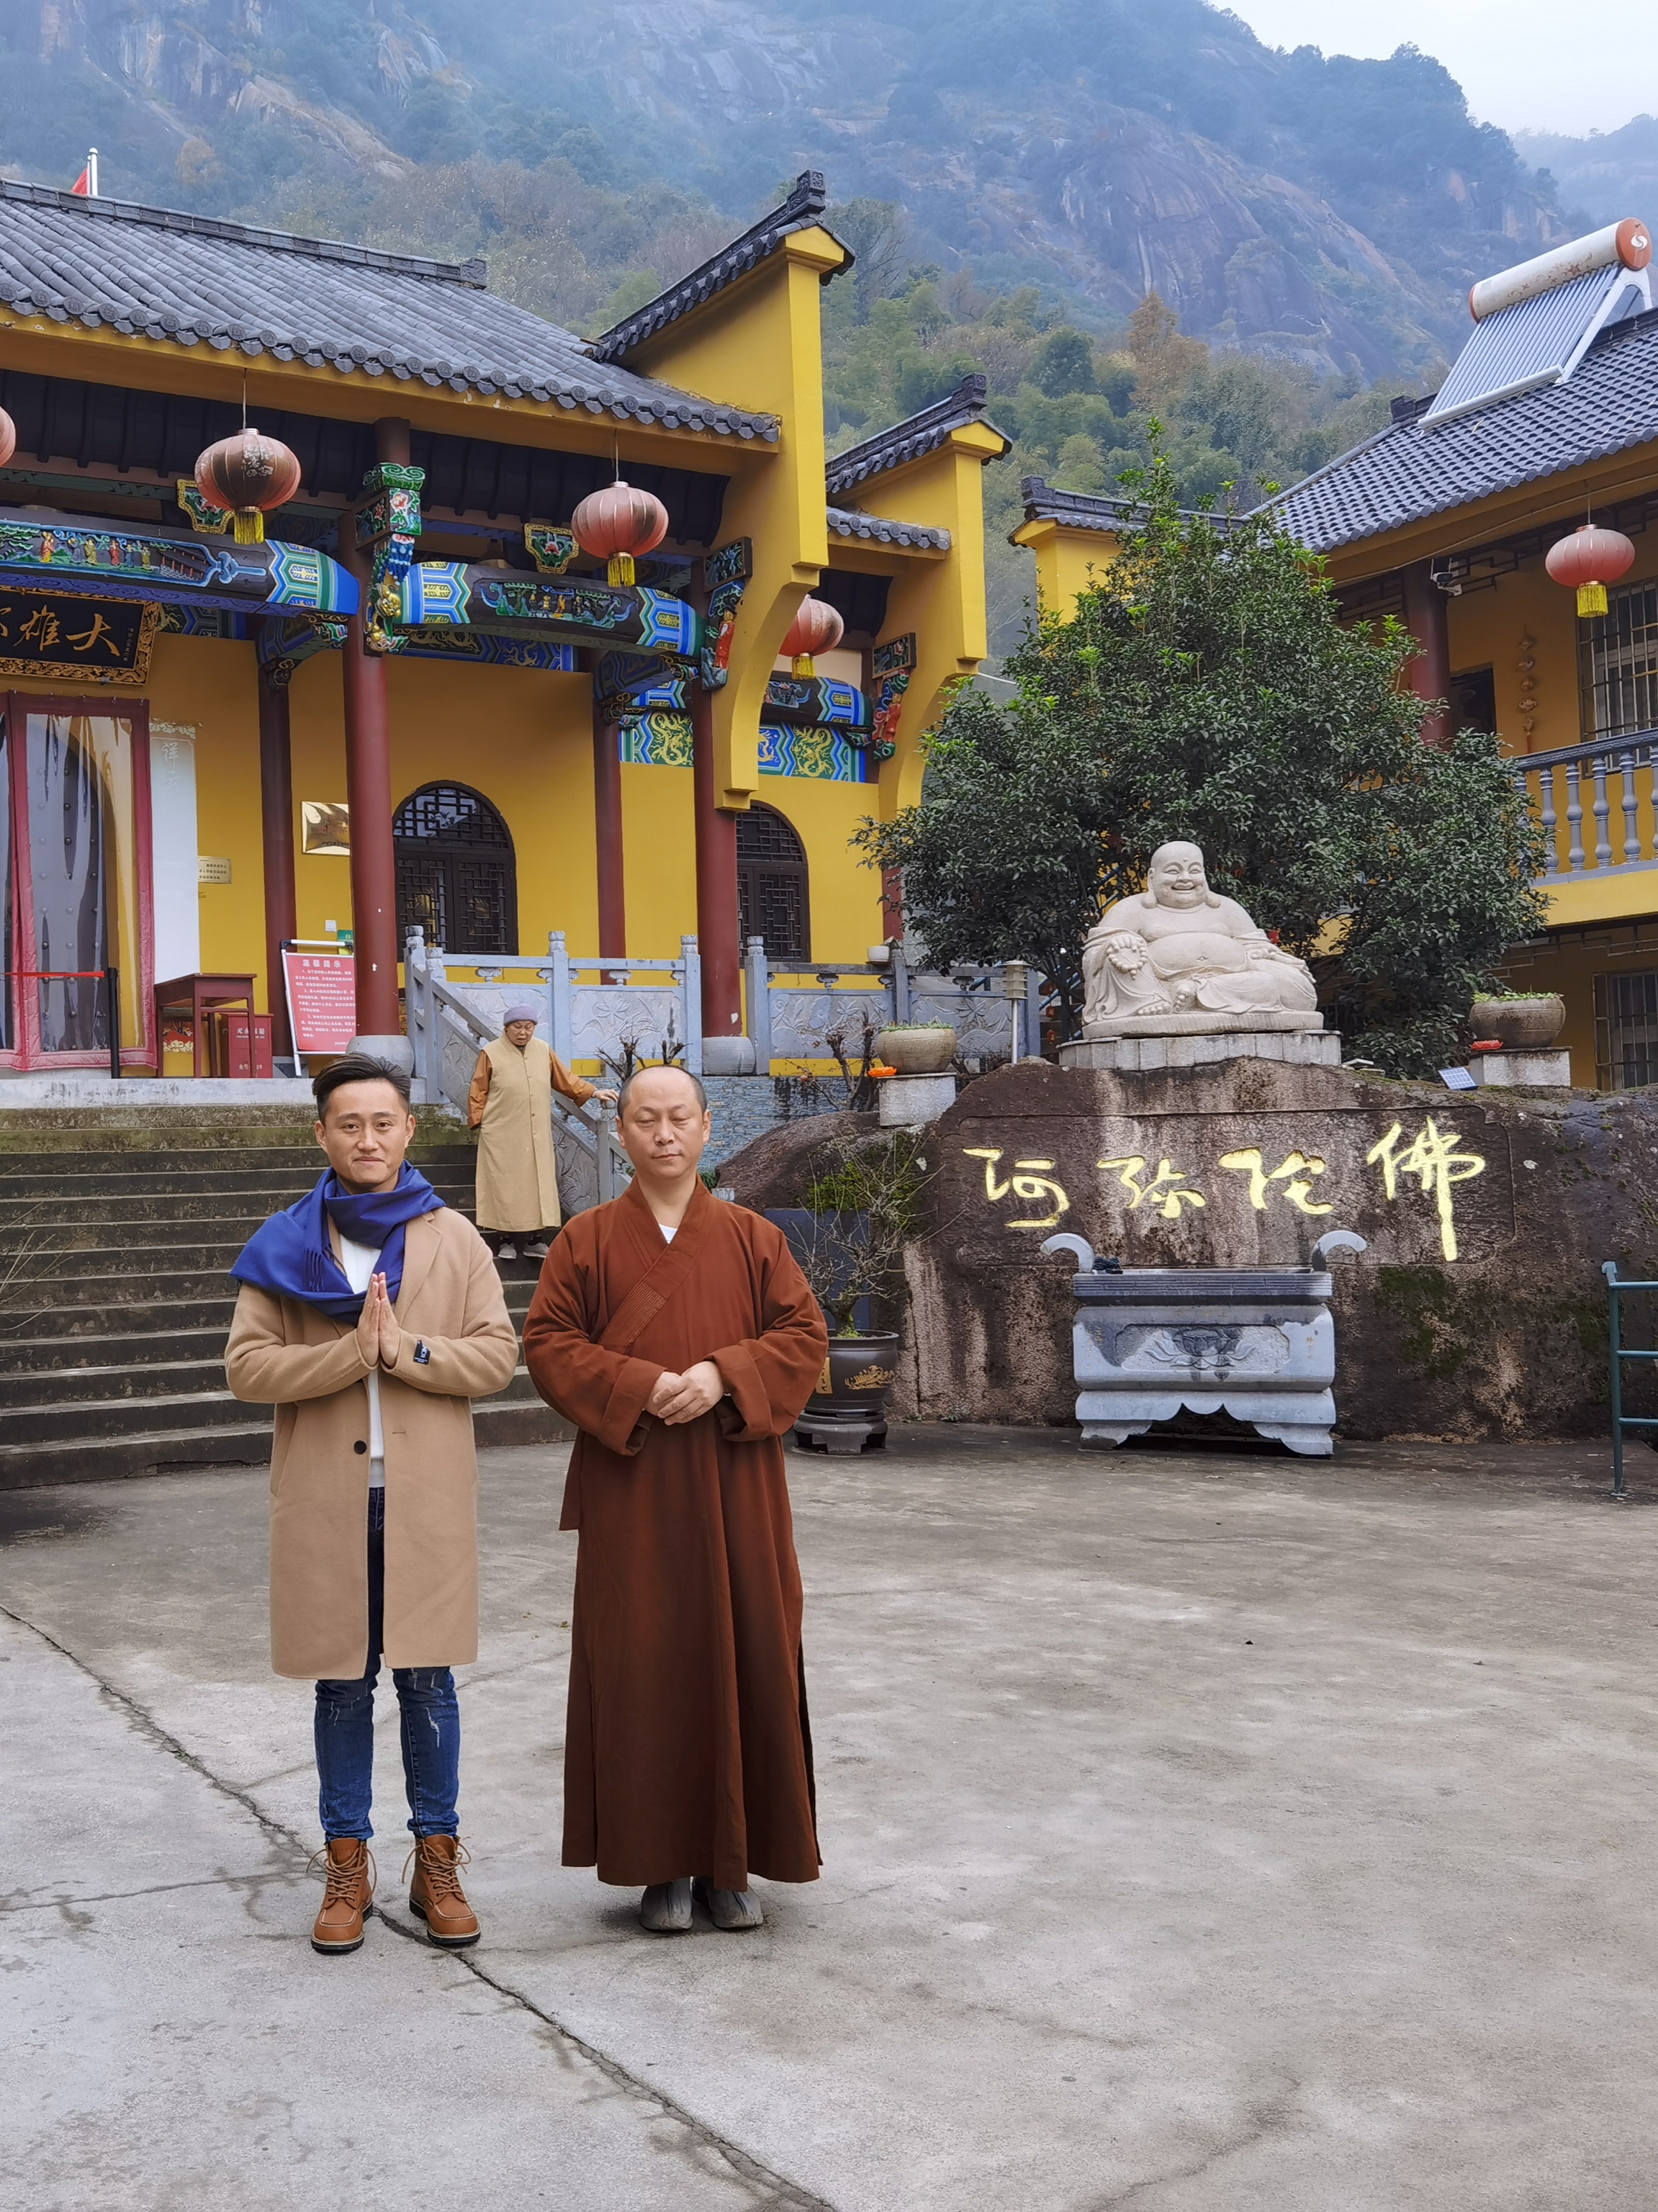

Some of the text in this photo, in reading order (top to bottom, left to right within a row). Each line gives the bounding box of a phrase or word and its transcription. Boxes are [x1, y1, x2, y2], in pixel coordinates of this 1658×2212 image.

[0, 604, 120, 657] 大雄
[963, 1116, 1485, 1262] 阿弥陀佛
